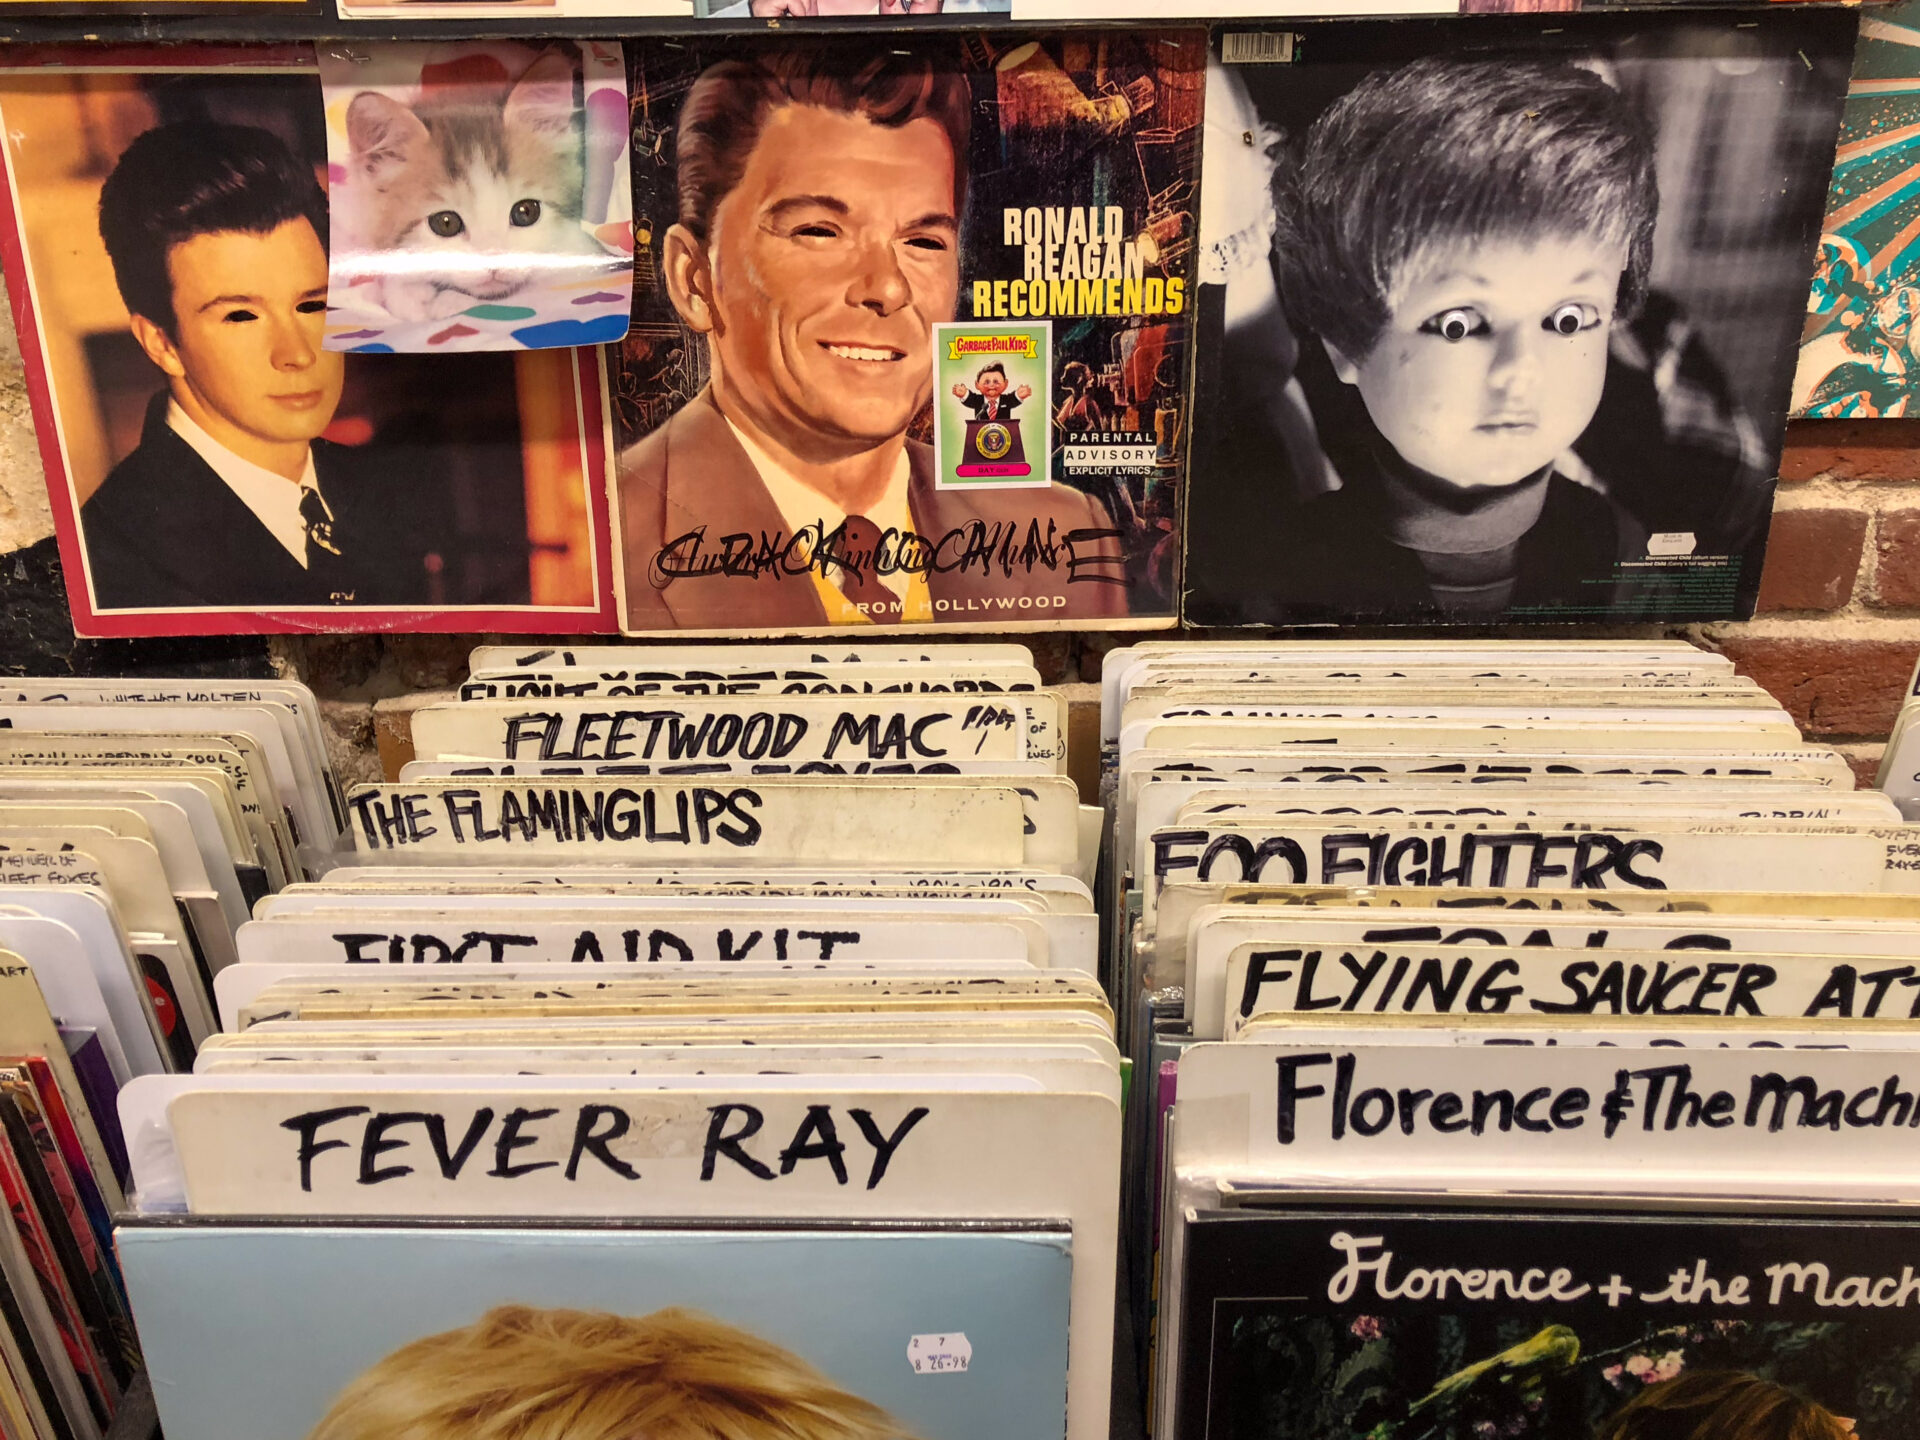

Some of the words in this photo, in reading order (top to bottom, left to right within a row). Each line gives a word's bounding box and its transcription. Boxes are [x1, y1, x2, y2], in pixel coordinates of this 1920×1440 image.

[1003, 206, 1123, 245] RONALD
[1024, 242, 1146, 281] REAGAN
[973, 277, 1184, 318] RECOMMENDS
[1065, 450, 1156, 460] ADVISORY
[1070, 433, 1152, 443] PARENTAL
[1069, 466, 1113, 475] EXPLICIT
[1115, 466, 1151, 475] LYRICS
[842, 602, 904, 615] FROM
[919, 596, 1067, 612] HOLLYWOOD
[502, 710, 808, 760] FLEETWOOD
[822, 712, 953, 759] MAC
[349, 790, 437, 850] THE
[1150, 830, 1307, 885] FOO
[1321, 832, 1668, 889] FIGHTERS
[1238, 950, 1524, 1018] FLYING
[1529, 961, 1777, 1016] SAUCER
[1275, 1052, 1590, 1145] Florence
[279, 1104, 642, 1192] FEVER
[699, 1104, 930, 1190] RAY
[1328, 1231, 1591, 1304] Florence
[1640, 1258, 1750, 1305] the
